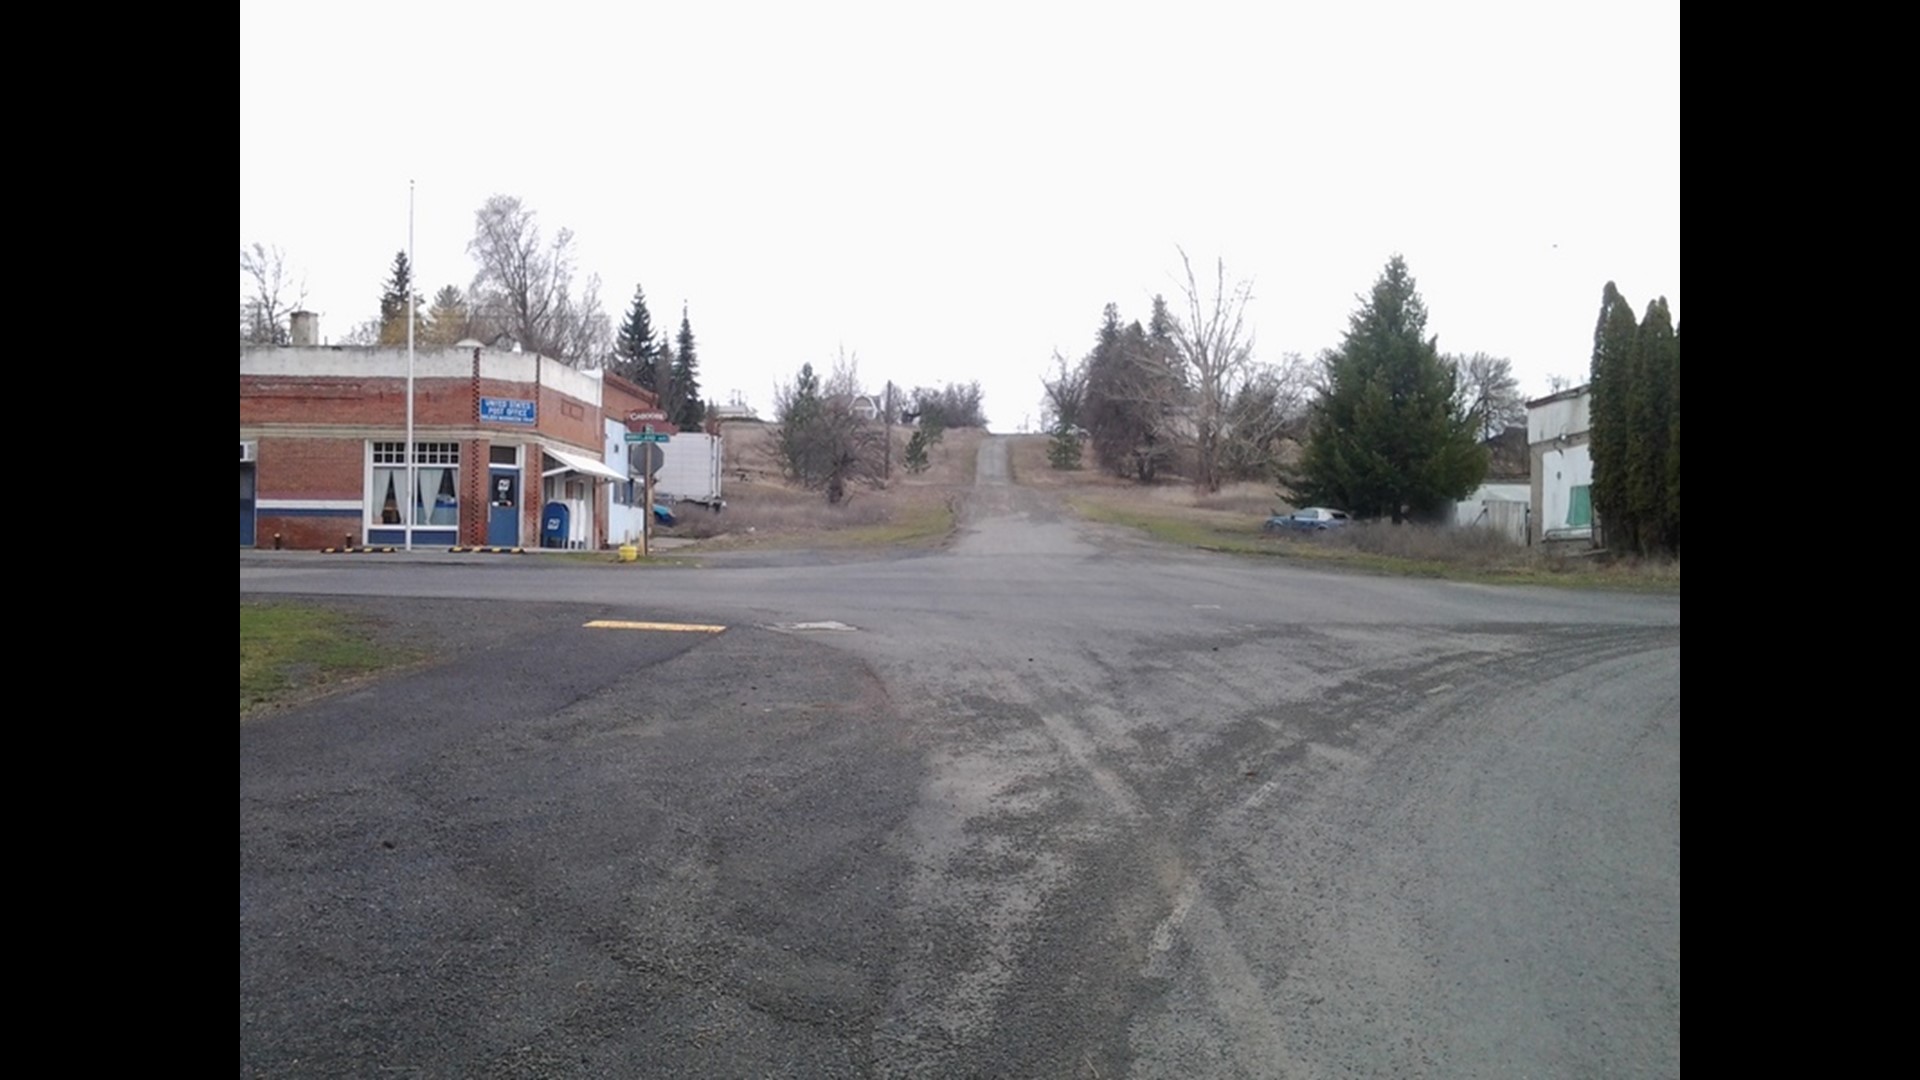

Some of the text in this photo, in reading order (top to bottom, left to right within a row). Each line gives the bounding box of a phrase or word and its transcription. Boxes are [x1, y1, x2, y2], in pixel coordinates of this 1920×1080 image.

[484, 399, 531, 410] UNITED STATES
[487, 407, 527, 416] POST OFFICE
